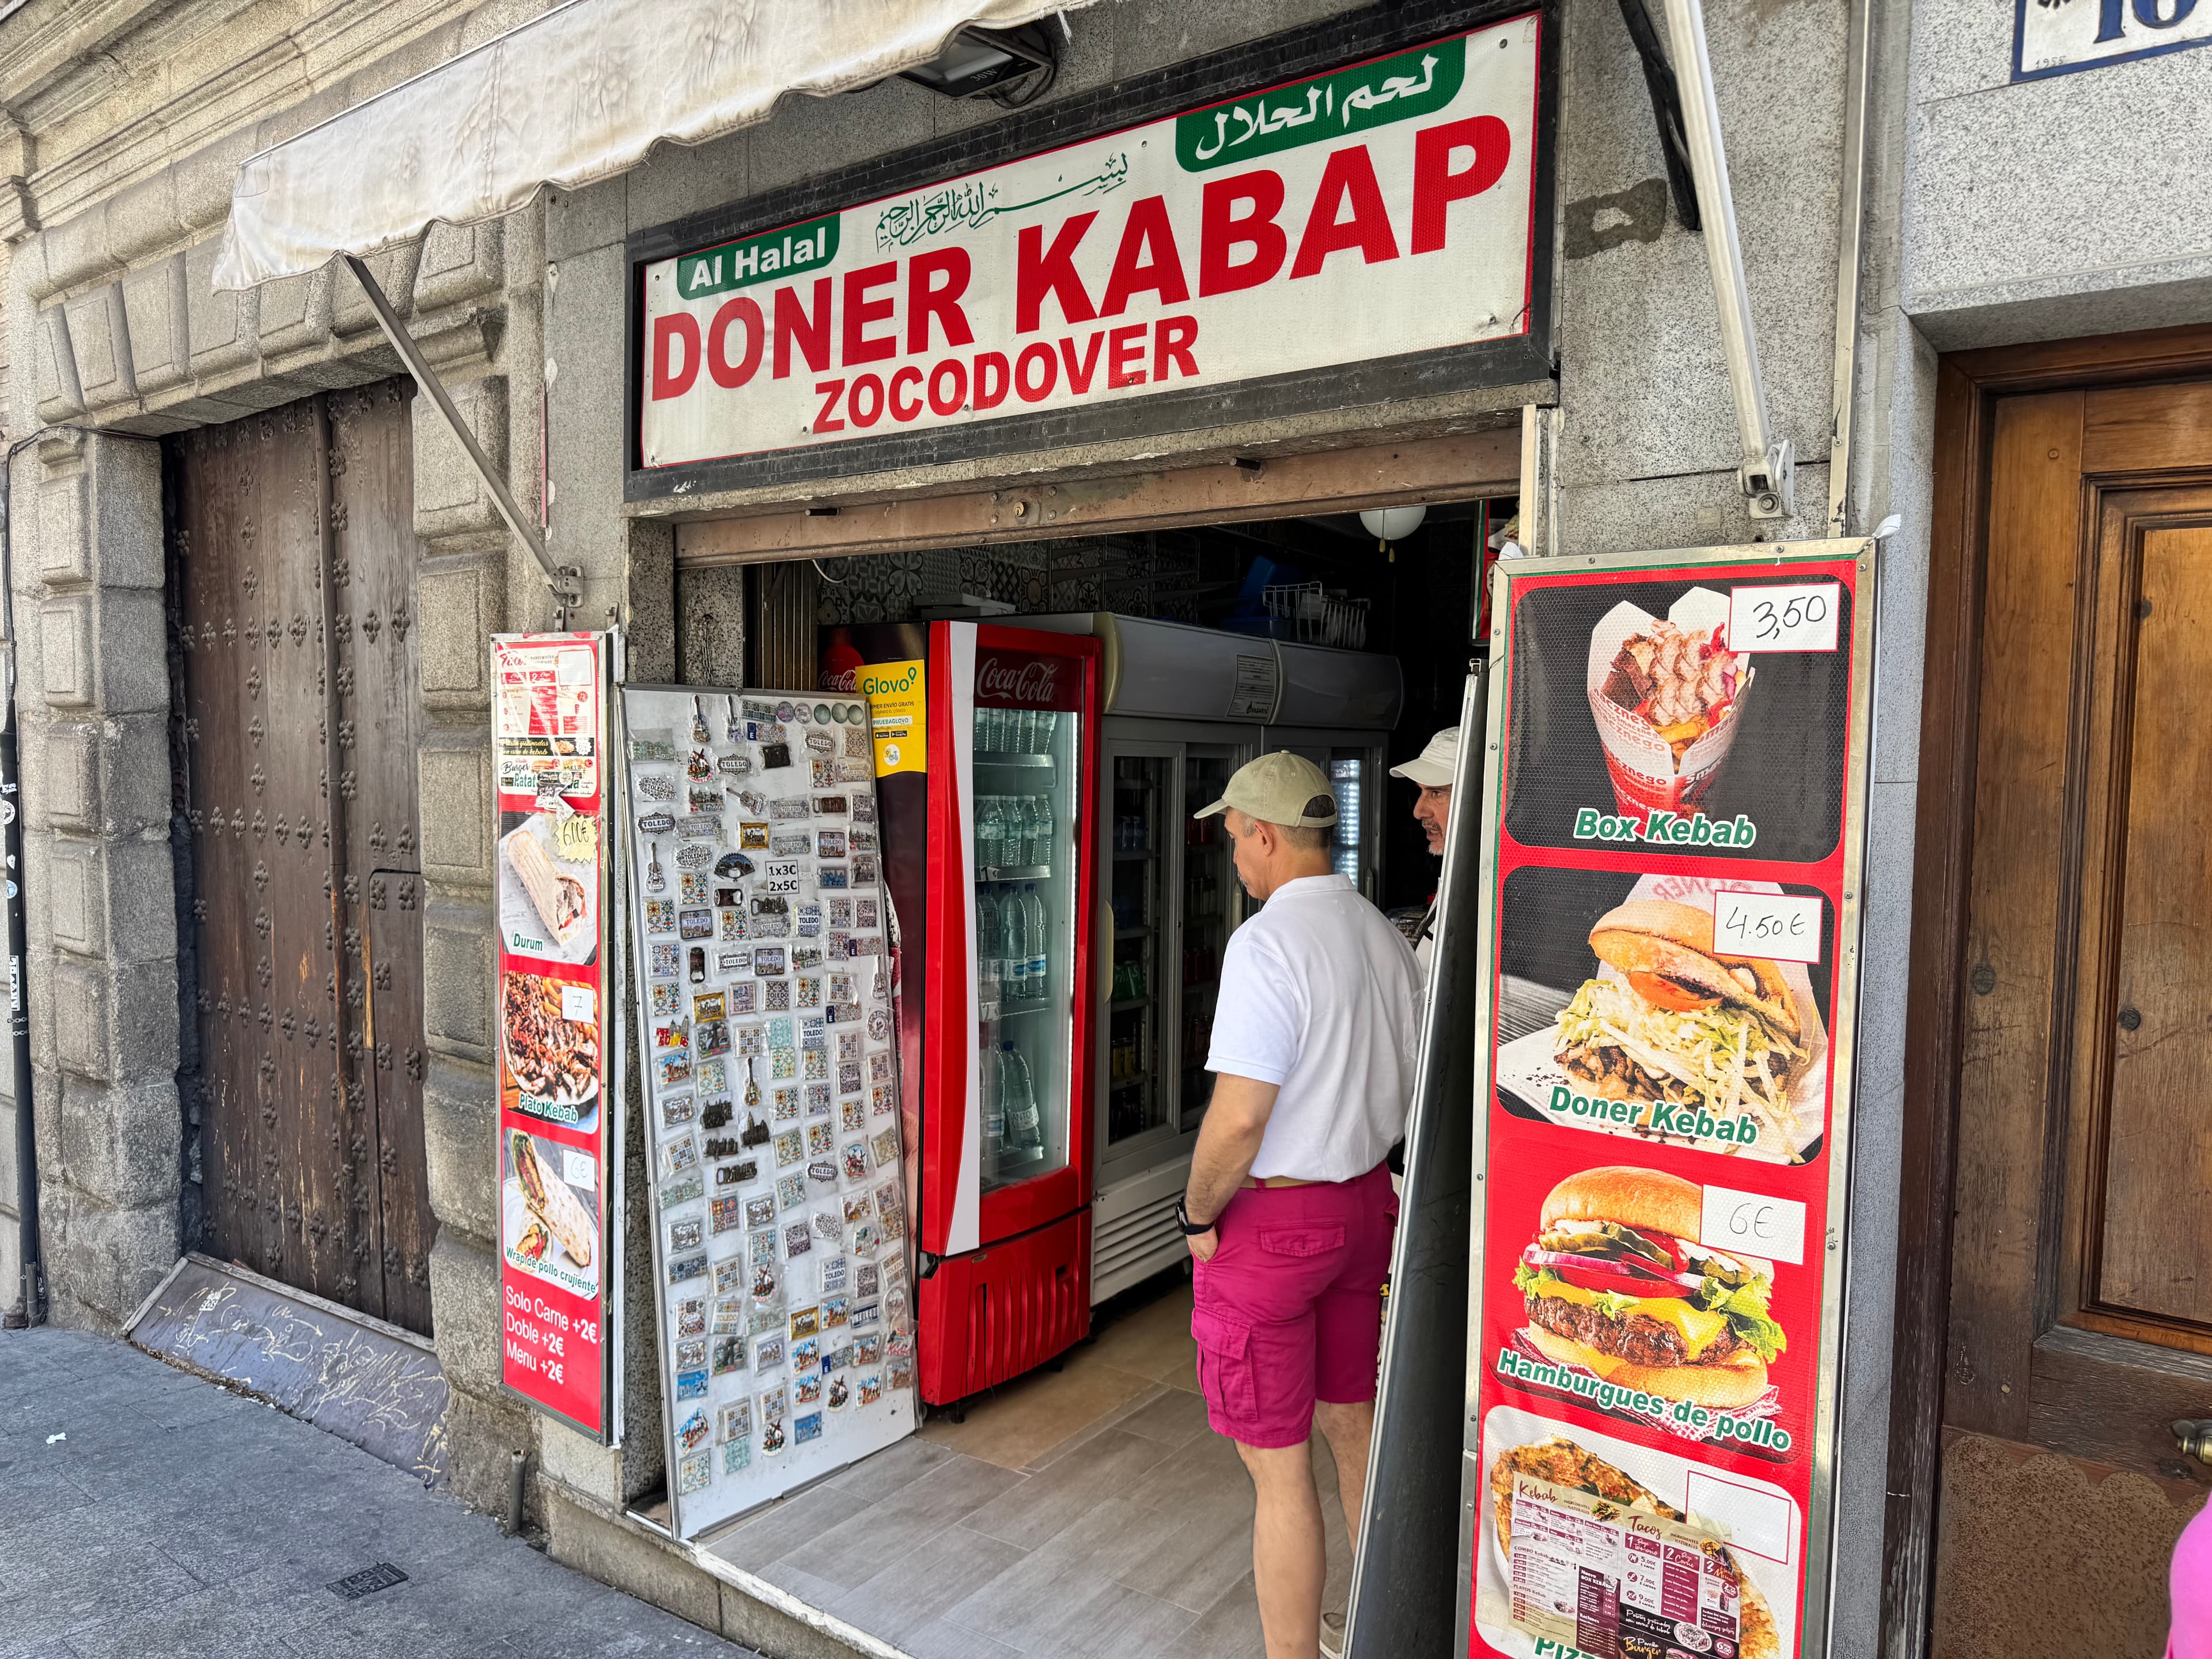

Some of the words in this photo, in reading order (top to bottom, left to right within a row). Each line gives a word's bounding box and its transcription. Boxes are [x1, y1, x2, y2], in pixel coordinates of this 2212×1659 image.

[2035, 55, 2066, 69] 1955
[970, 69, 998, 82] 30W
[1342, 54, 1439, 129] لحم
[1195, 83, 1332, 160] الحلال
[652, 247, 975, 401] DONER
[1016, 115, 1512, 334] KABAP
[690, 255, 722, 290] Al
[735, 226, 825, 279] Halal
[813, 315, 1199, 434] ZOCODOVER
[1753, 596, 1827, 639] 3,50
[863, 676, 910, 695] Glovo
[977, 657, 1059, 702] Coca-Cola
[647, 784, 667, 793] TOLEDO
[1575, 809, 1637, 838] Box
[1646, 813, 1753, 845] Kebab
[769, 865, 796, 876] 1x3€
[770, 880, 797, 891] 2x5€
[513, 933, 543, 952] Durum
[520, 1094, 542, 1111] Plato
[544, 1102, 578, 1122] Kebab
[1550, 1087, 1637, 1124] Doner
[1652, 1103, 1757, 1144] Kebab
[812, 1167, 834, 1175] TOLEDO
[1729, 1203, 1774, 1238] 6€
[506, 1245, 525, 1266] Wrap
[525, 1256, 537, 1269] de
[537, 1259, 558, 1278] pollo
[560, 1270, 597, 1294] crujiente
[825, 1270, 844, 1280] TOLEDO
[506, 1285, 531, 1313] Solo
[534, 1297, 569, 1331] Carne
[572, 1318, 597, 1344] +2€
[506, 1312, 539, 1343] Doble
[541, 1332, 565, 1357] +2€
[506, 1338, 537, 1372] Menu
[540, 1359, 563, 1384] +2€
[1498, 1350, 1664, 1414] Hamburgues
[1673, 1400, 1708, 1426] de
[1716, 1415, 1790, 1450] pollo
[1519, 1480, 1558, 1503] Kebab
[1563, 1499, 1590, 1510] INGREDIENTES
[1567, 1505, 1590, 1515] NATURALES
[1628, 1516, 1662, 1540] Tacos
[1628, 1537, 1633, 1548] 1
[1670, 1533, 1699, 1544] INGREDIENTES
[1675, 1539, 1698, 1550] NATURALES
[1514, 1546, 1533, 1554] COMBO
[1535, 1551, 1550, 1559] Kebab
[1665, 1548, 1675, 1559] 2
[1581, 1570, 1597, 1578] Nuevo
[1706, 1560, 1714, 1573] 3
[1581, 1575, 1592, 1583] BOX
[1513, 1584, 1532, 1594] PLATOS
[1532, 1589, 1547, 1599] Kebab
[1580, 1613, 1600, 1624] Raciones
[1623, 1637, 1661, 1659] Burger
